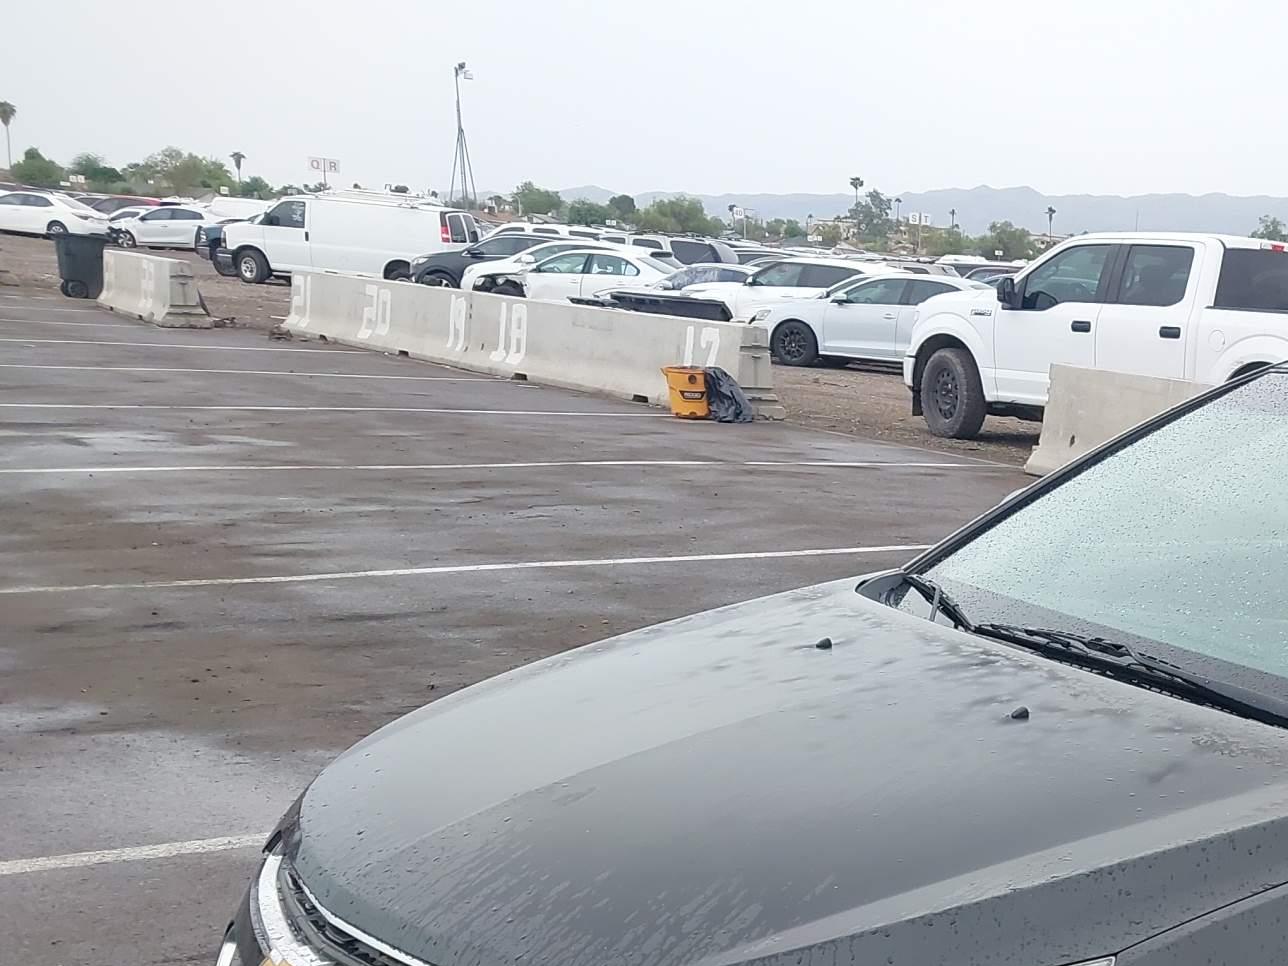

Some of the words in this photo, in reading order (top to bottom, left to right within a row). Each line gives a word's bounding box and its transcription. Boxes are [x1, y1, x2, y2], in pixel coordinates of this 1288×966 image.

[310, 159, 321, 170] Q
[328, 161, 338, 171] R
[281, 274, 311, 329] 21
[357, 284, 392, 340] 20
[489, 301, 528, 365] 18
[683, 325, 721, 368] 17
